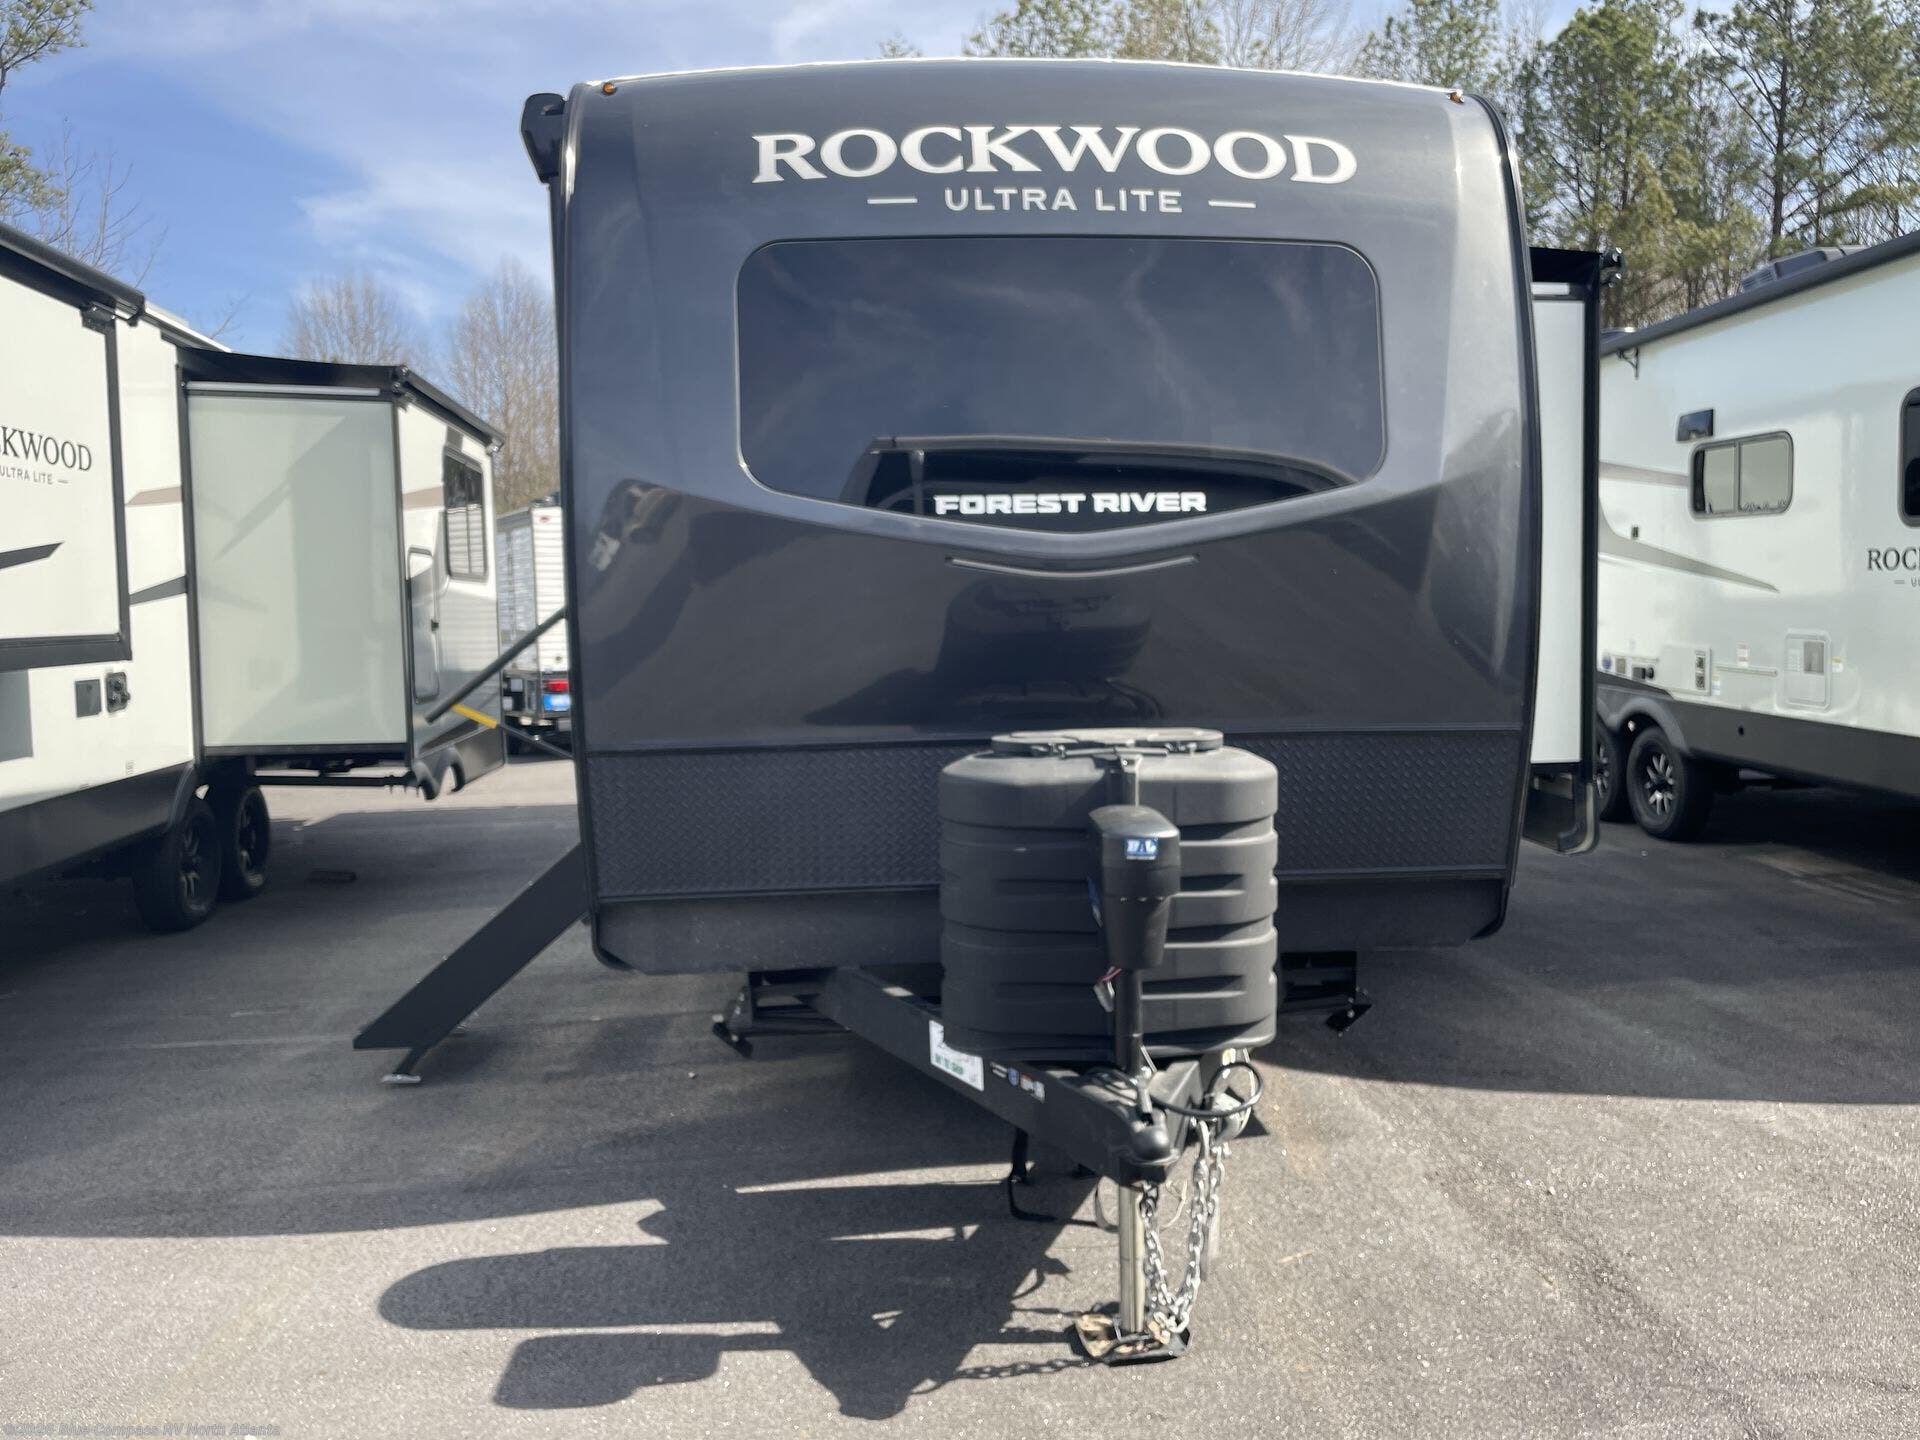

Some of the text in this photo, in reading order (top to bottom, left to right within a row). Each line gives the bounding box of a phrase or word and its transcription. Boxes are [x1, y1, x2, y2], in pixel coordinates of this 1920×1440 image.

[751, 125, 1357, 184] ROCKWOOD
[944, 187, 1182, 213] ULTRA LITE
[0, 425, 92, 471] KWOOD
[32, 470, 53, 485] LITE
[933, 491, 1207, 515] FOREST RIVER
[1866, 546, 1920, 571] ROC
